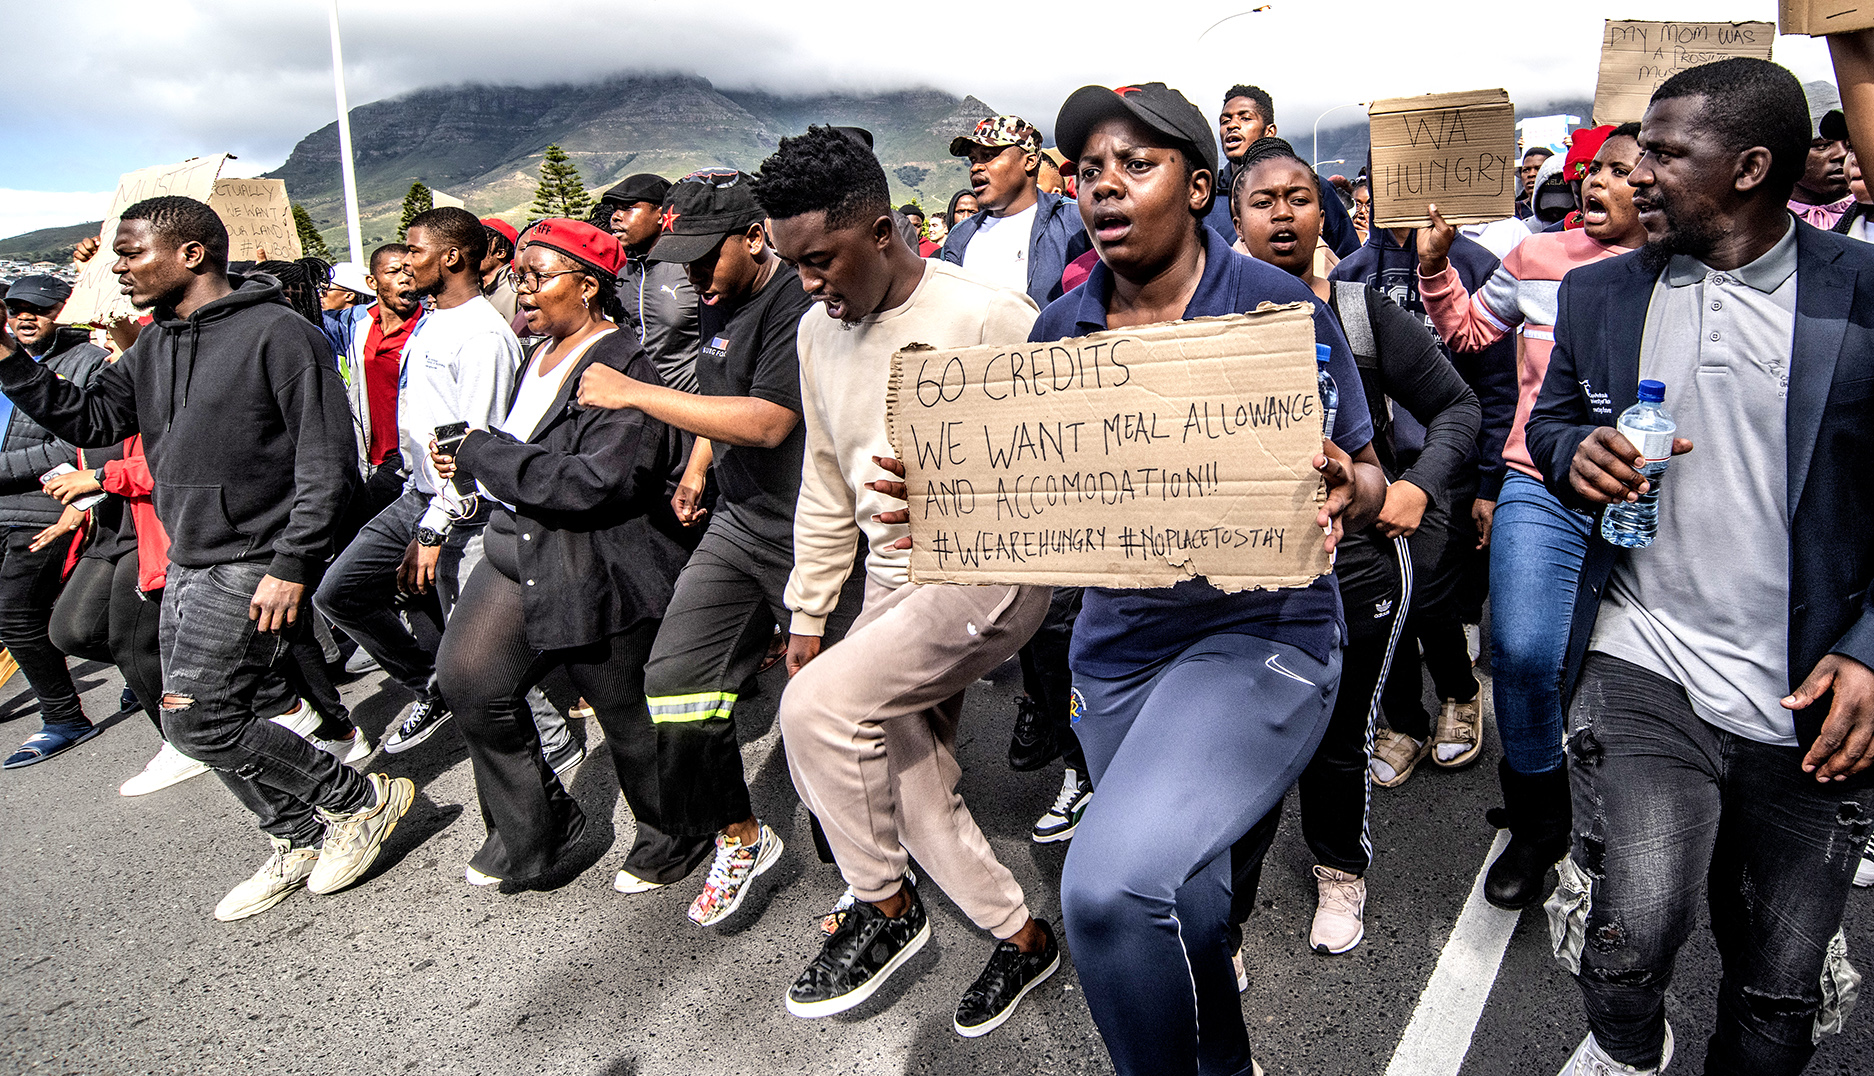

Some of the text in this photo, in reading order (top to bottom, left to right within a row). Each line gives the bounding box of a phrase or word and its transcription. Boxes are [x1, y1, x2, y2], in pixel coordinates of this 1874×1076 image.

[1611, 24, 1756, 54] MY MOM WAS
[1652, 46, 1664, 60] A
[1638, 65, 1687, 80] MUS
[1402, 109, 1468, 150] WA
[214, 183, 274, 202] CTUALLY
[1386, 152, 1508, 198] HUNGRY
[225, 202, 277, 221] WE WANT
[225, 222, 284, 239] OUR LAND
[916, 339, 1131, 407] 60 CREDITS
[911, 393, 1314, 470] WE WANT MEAL ALLOWANCE
[925, 461, 1218, 521] AND ACCOMODATION!!
[932, 525, 1285, 569] #WEAREHUNGRY #NOPLACETOSTAY
